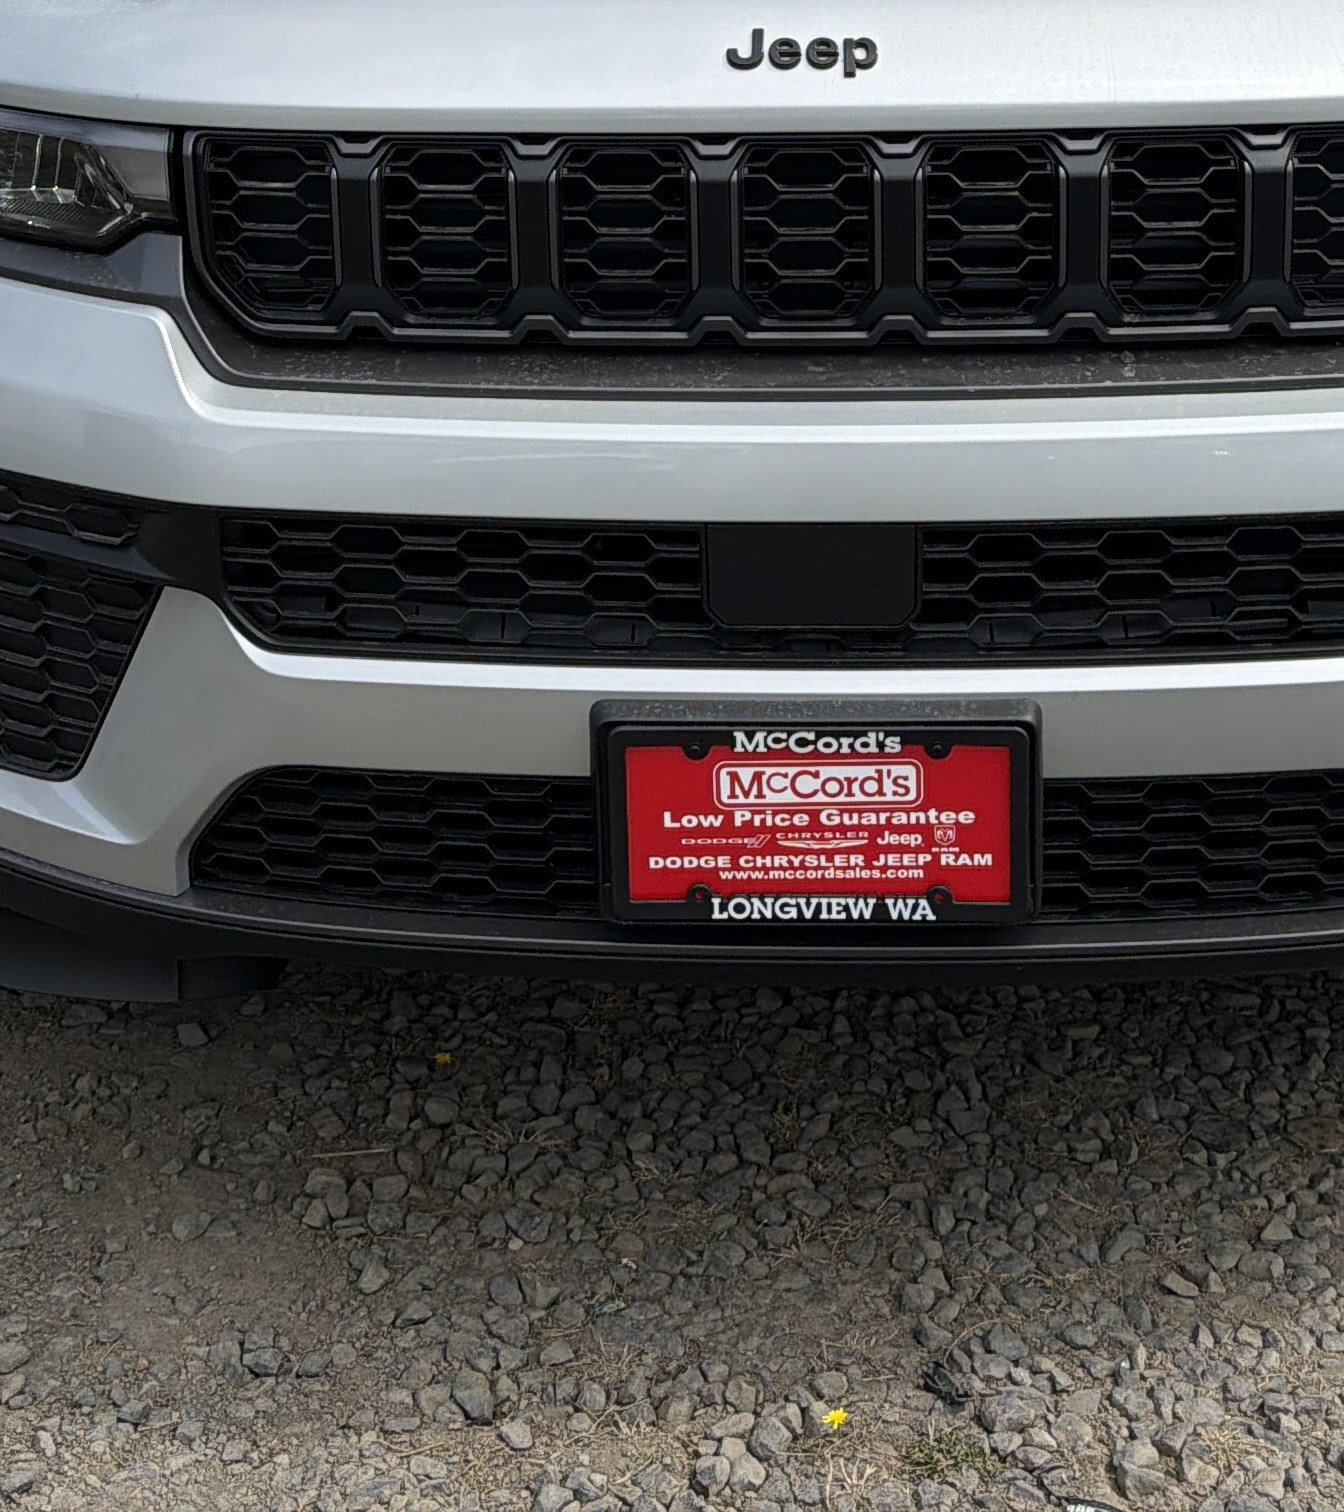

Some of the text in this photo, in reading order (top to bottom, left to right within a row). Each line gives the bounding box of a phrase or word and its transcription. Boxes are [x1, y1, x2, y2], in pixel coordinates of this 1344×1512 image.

[725, 27, 879, 78] Jeep
[732, 730, 902, 754] McCord's
[725, 768, 911, 801] McCord's
[663, 807, 976, 829] Low Price Guarantee
[775, 831, 869, 840] CHRYSLER
[876, 830, 923, 848] Jeep
[648, 852, 993, 870] DODGE CHRYSLER JEEP RAM
[718, 866, 924, 880] www.mccordsales.com
[711, 897, 937, 921] LONGVIEW WA
